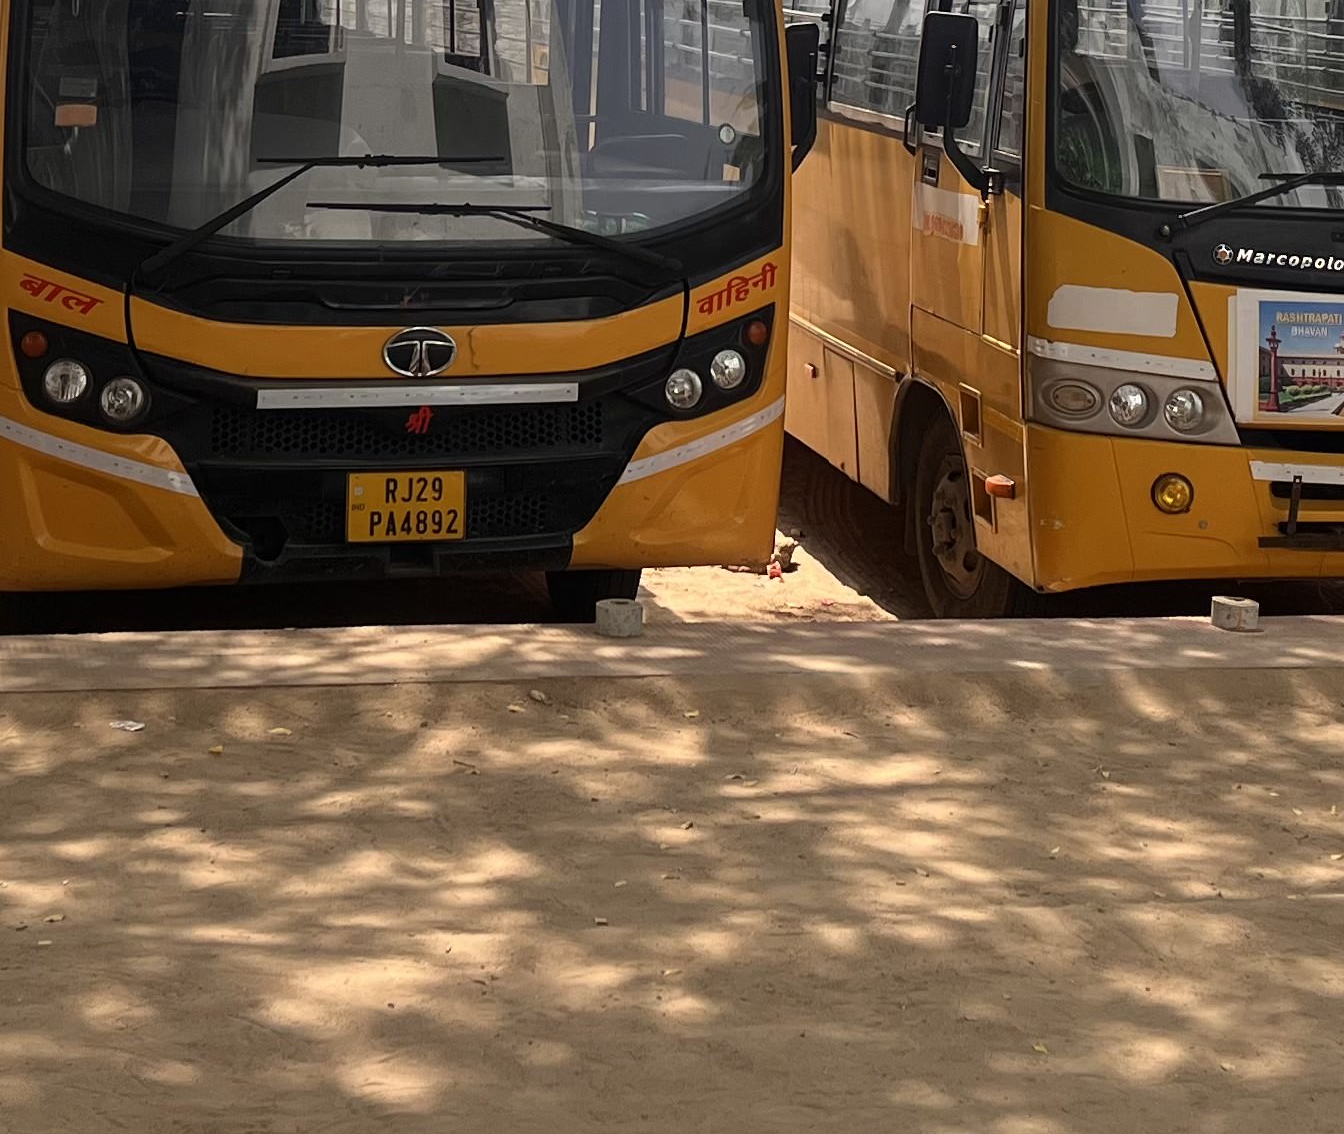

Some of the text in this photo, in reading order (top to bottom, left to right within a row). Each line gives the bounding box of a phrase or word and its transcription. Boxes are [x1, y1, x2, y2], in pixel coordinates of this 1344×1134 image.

[1236, 248, 1344, 272] Marcopolo
[19, 272, 105, 315] बाल
[696, 262, 778, 315] वाहिनी
[1276, 311, 1343, 325] RASHTRAPATI
[1291, 326, 1329, 338] BHAVAN
[385, 476, 443, 504] RJ29
[369, 509, 459, 537] PA4892
